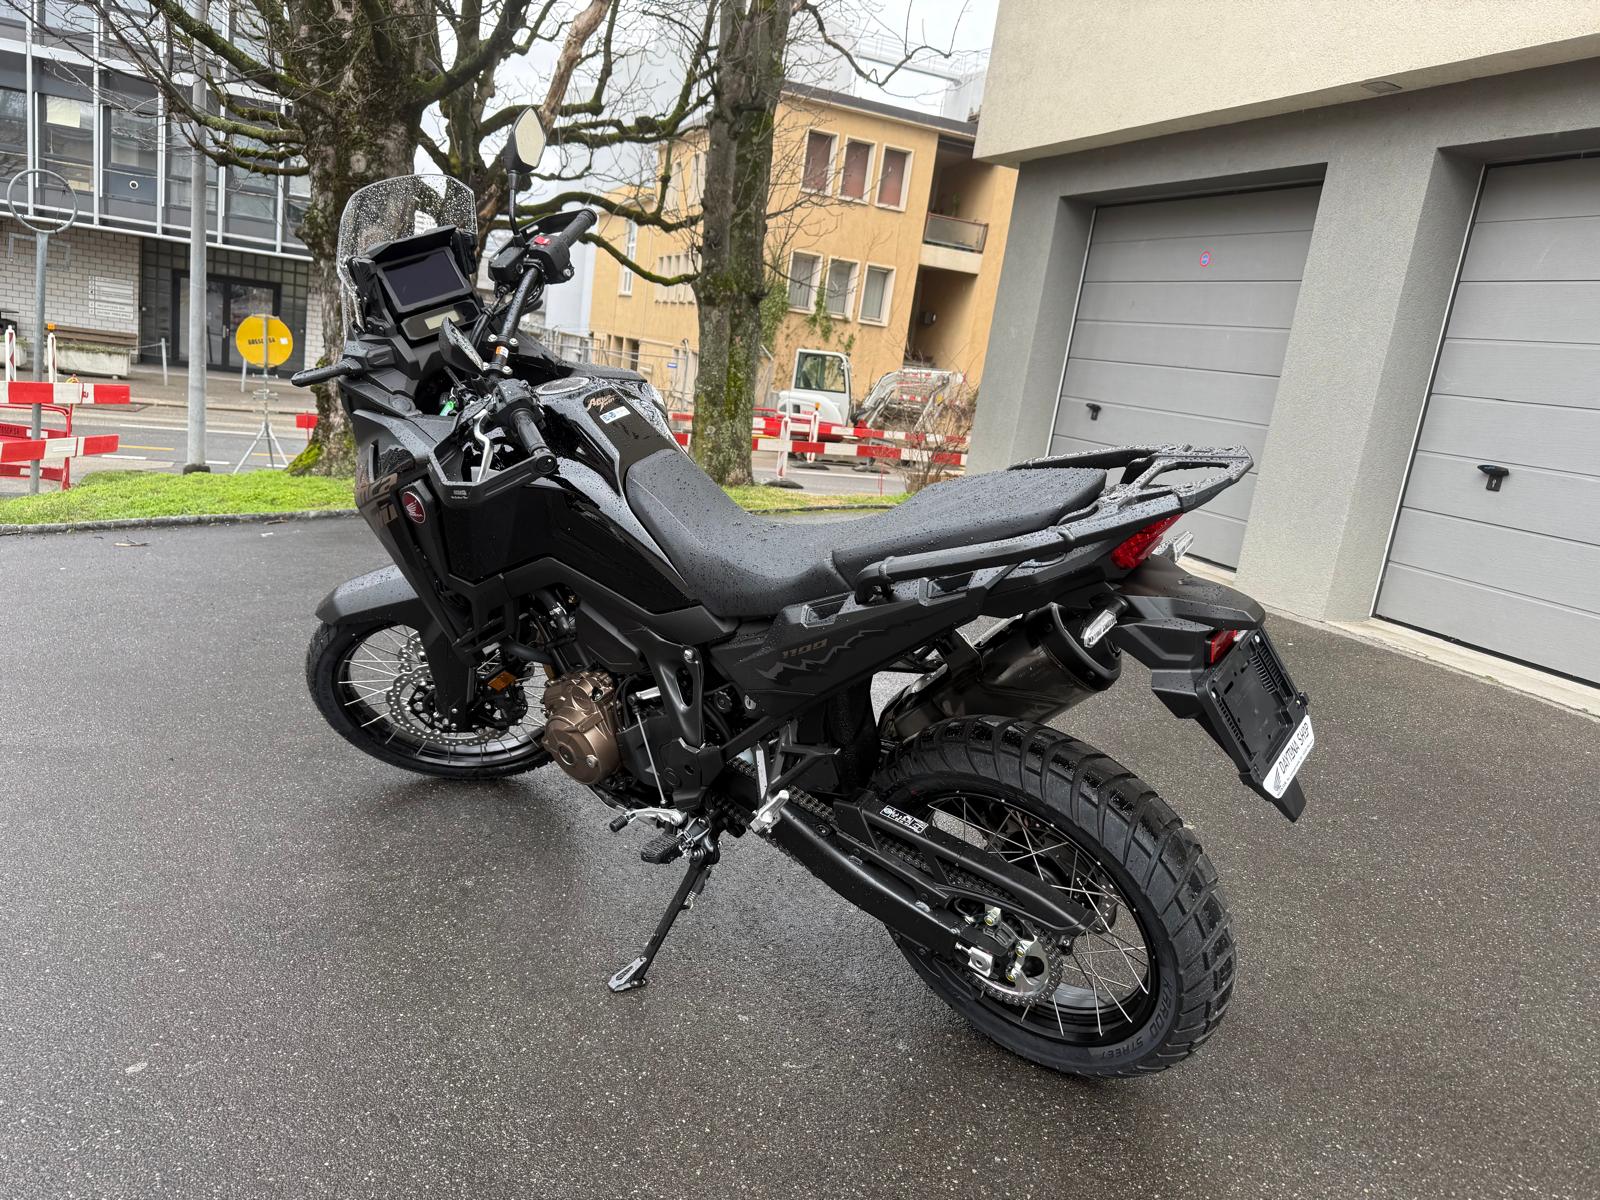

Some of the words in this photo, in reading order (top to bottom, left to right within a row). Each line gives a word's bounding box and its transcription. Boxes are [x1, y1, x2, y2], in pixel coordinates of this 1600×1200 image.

[1278, 740, 1300, 774] DAYTONA
[1297, 722, 1309, 746] SHOP
[1149, 976, 1174, 1039] KAROO
